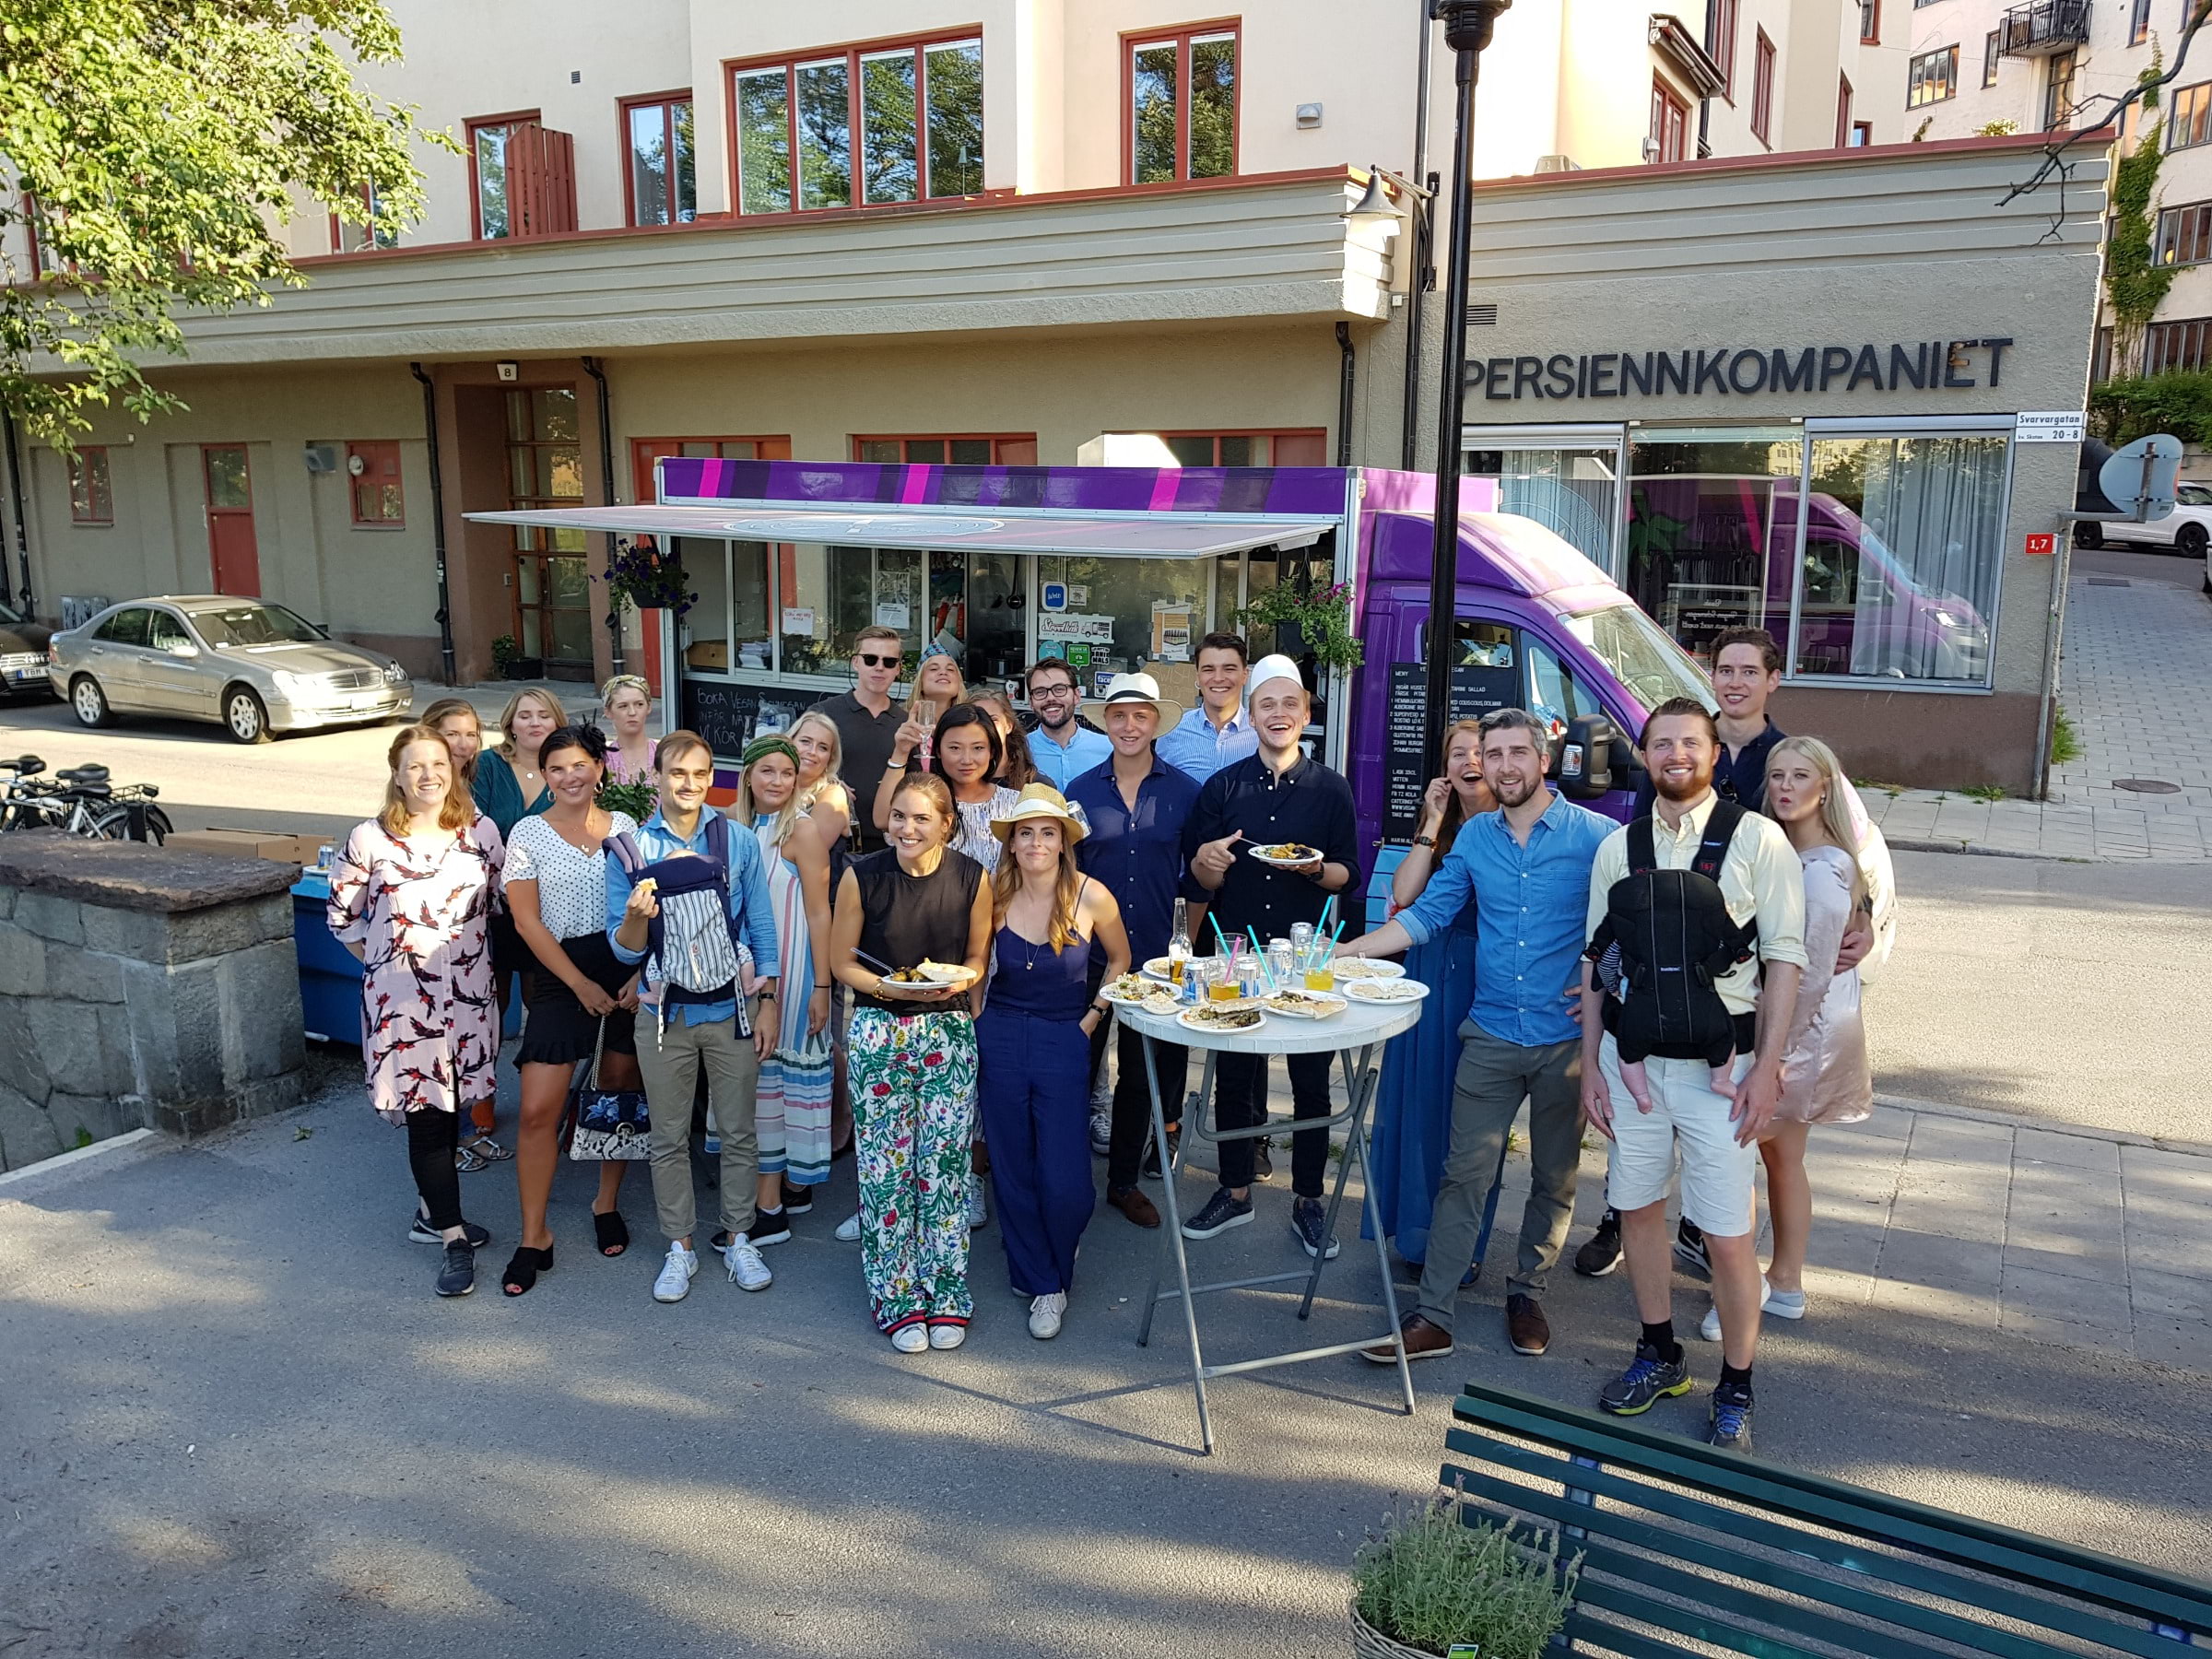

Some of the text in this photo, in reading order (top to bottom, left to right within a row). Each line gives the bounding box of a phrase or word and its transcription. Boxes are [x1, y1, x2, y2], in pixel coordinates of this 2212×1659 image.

[504, 368, 512, 377] 8
[1464, 337, 2013, 400] PERSIENNKOMPANIET
[2019, 415, 2080, 426] Svarvargatan
[2030, 539, 2049, 551] 1,7
